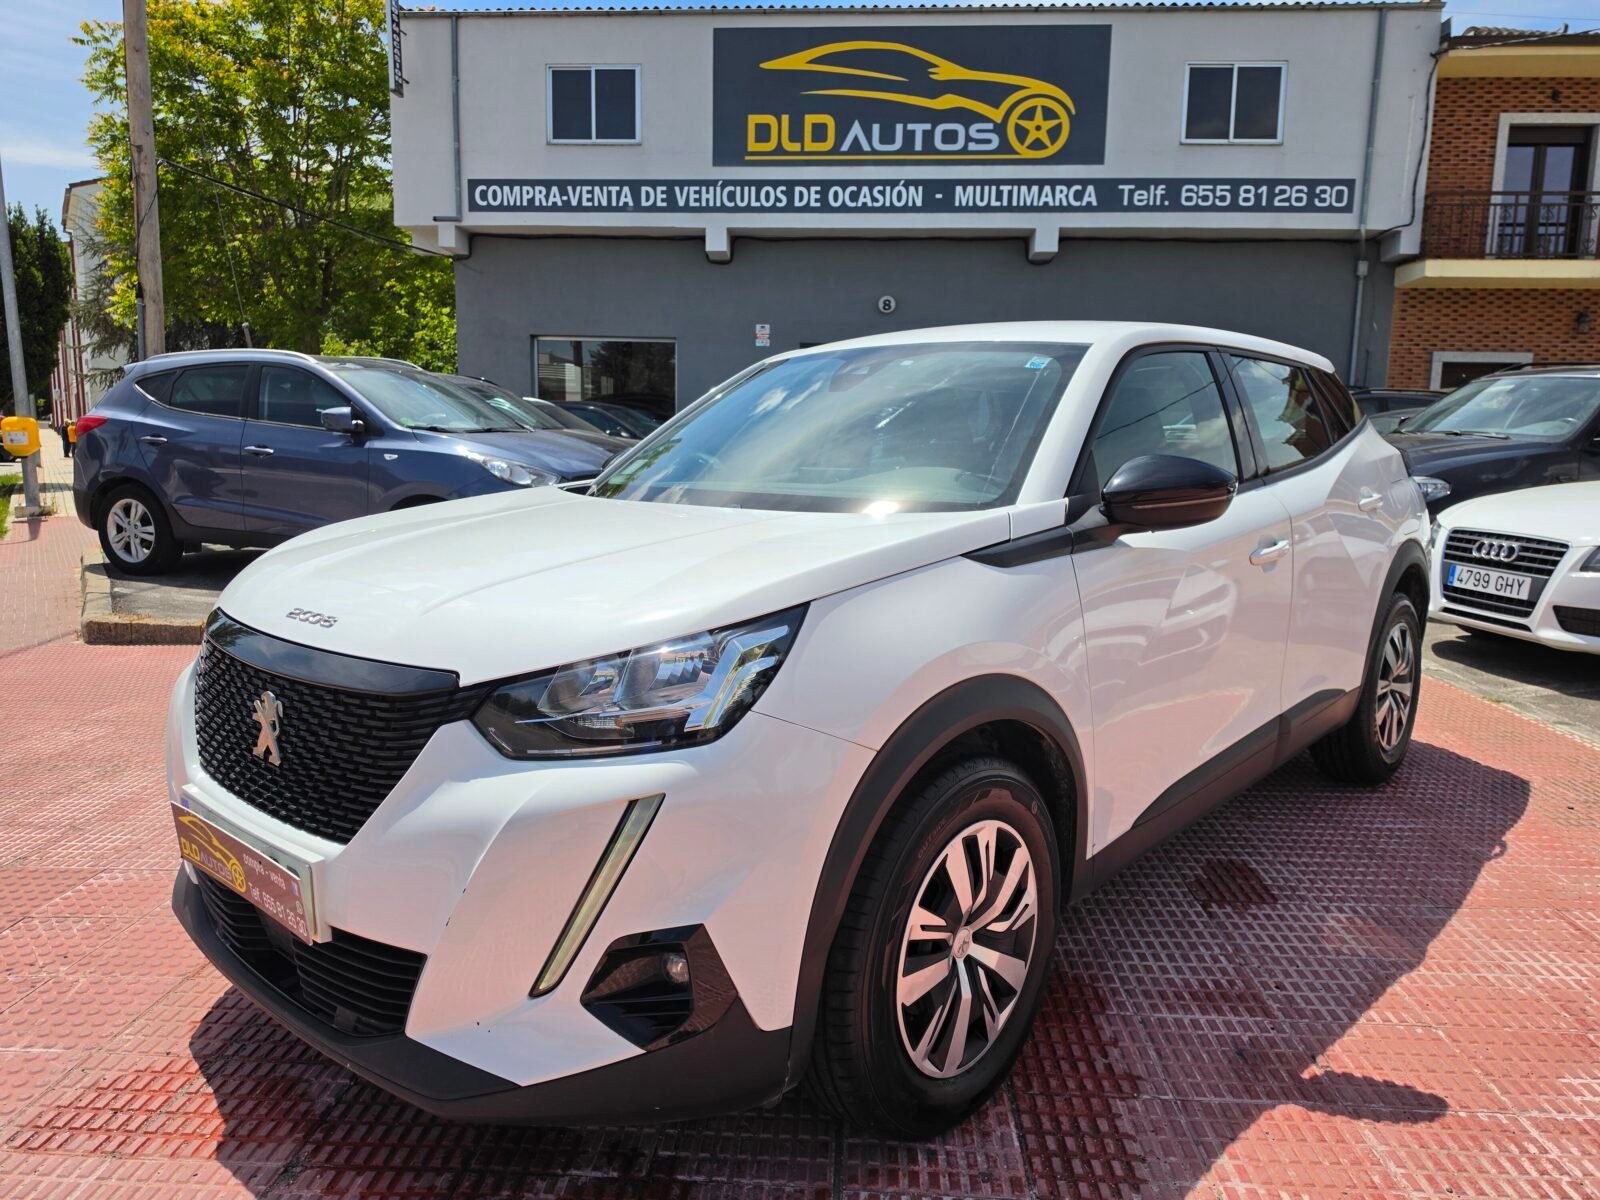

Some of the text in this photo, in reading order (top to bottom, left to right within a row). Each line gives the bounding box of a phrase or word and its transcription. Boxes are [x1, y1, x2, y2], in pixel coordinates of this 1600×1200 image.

[747, 113, 1000, 152] DLD AUTOS
[474, 184, 634, 208] COMPRA-VENTA
[640, 185, 667, 207] DE
[675, 180, 787, 208] VEHÍCULOS
[794, 185, 821, 208] DE
[829, 181, 923, 208] OCASIÓN
[955, 184, 1098, 207] MULTIMARCA
[1119, 184, 1170, 207] Telf.
[1180, 184, 1231, 207] 655
[1238, 184, 1268, 207] 81
[1274, 185, 1308, 207] 26
[1315, 184, 1349, 207] 30
[883, 299, 891, 310] 8
[1456, 568, 1525, 596] 4799 GHY
[285, 608, 338, 628] 2008
[180, 836, 231, 880] DLD AUTOS
[243, 853, 265, 876] compra
[269, 870, 286, 890] venta
[262, 891, 277, 914] 655
[276, 901, 286, 921] 81
